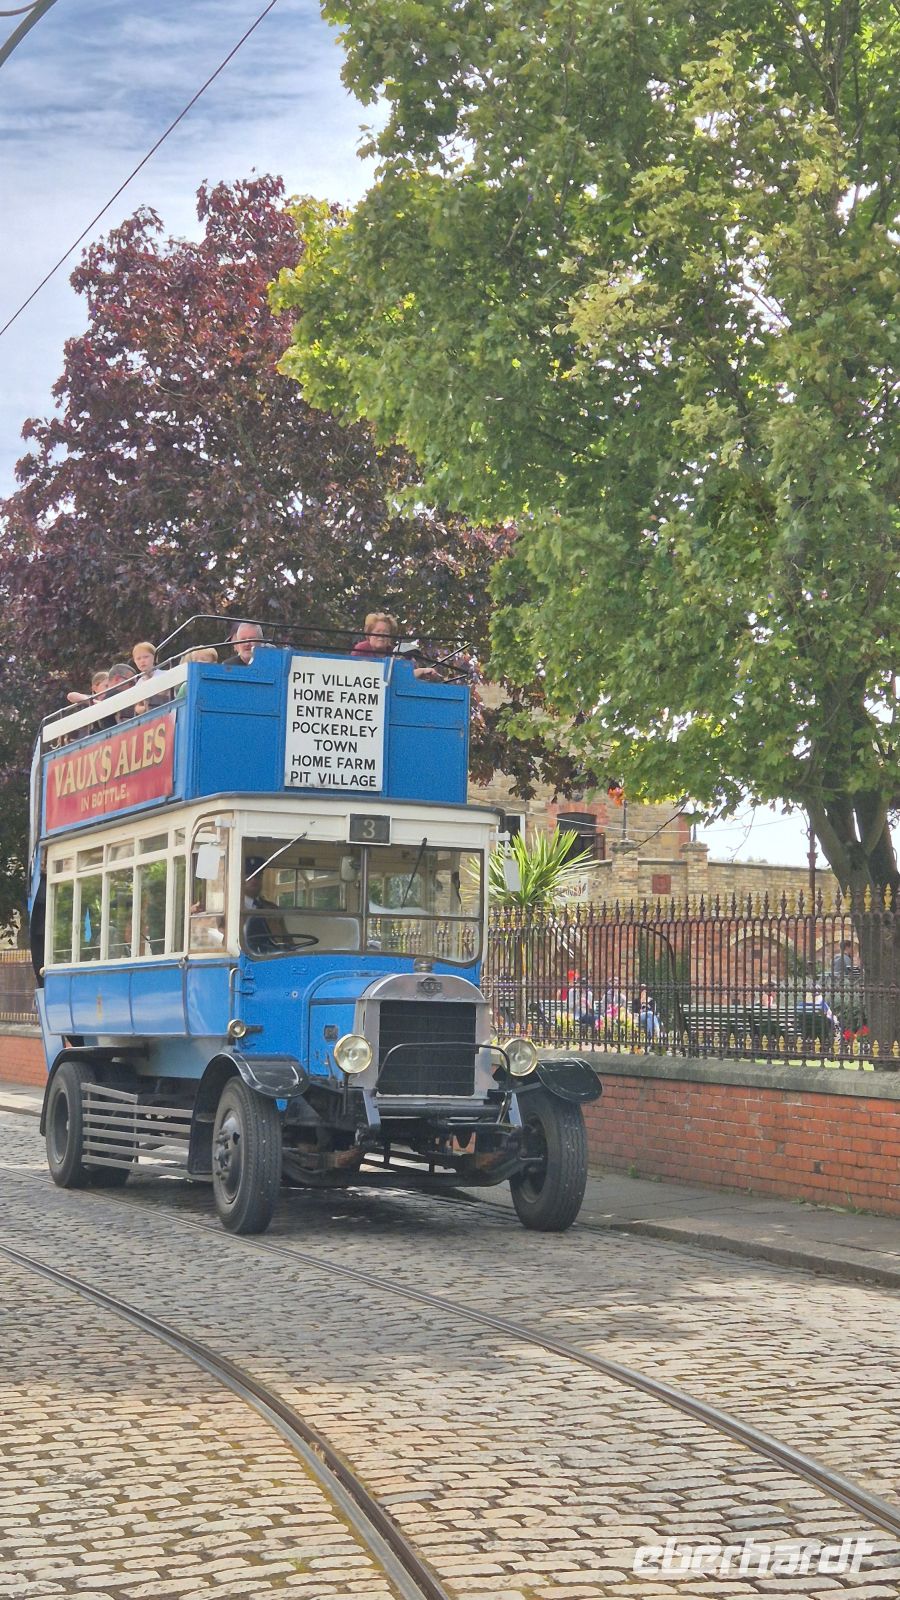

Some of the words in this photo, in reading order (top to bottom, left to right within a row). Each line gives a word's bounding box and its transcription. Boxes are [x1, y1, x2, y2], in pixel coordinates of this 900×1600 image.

[292, 671, 315, 685] PIT
[322, 673, 381, 689] VILLAGE
[293, 688, 335, 703] HOME
[340, 691, 379, 706] FARM
[296, 705, 373, 722] ENTRANCE
[292, 721, 378, 738] POCKERLEY
[114, 723, 166, 779] ALES
[313, 739, 358, 753] TOWN
[291, 754, 332, 768] HOME
[337, 757, 376, 771] FARM
[290, 771, 311, 784] PIT
[318, 772, 377, 787] VILLAGE
[80, 795, 89, 812] IN
[362, 819, 376, 839] 3
